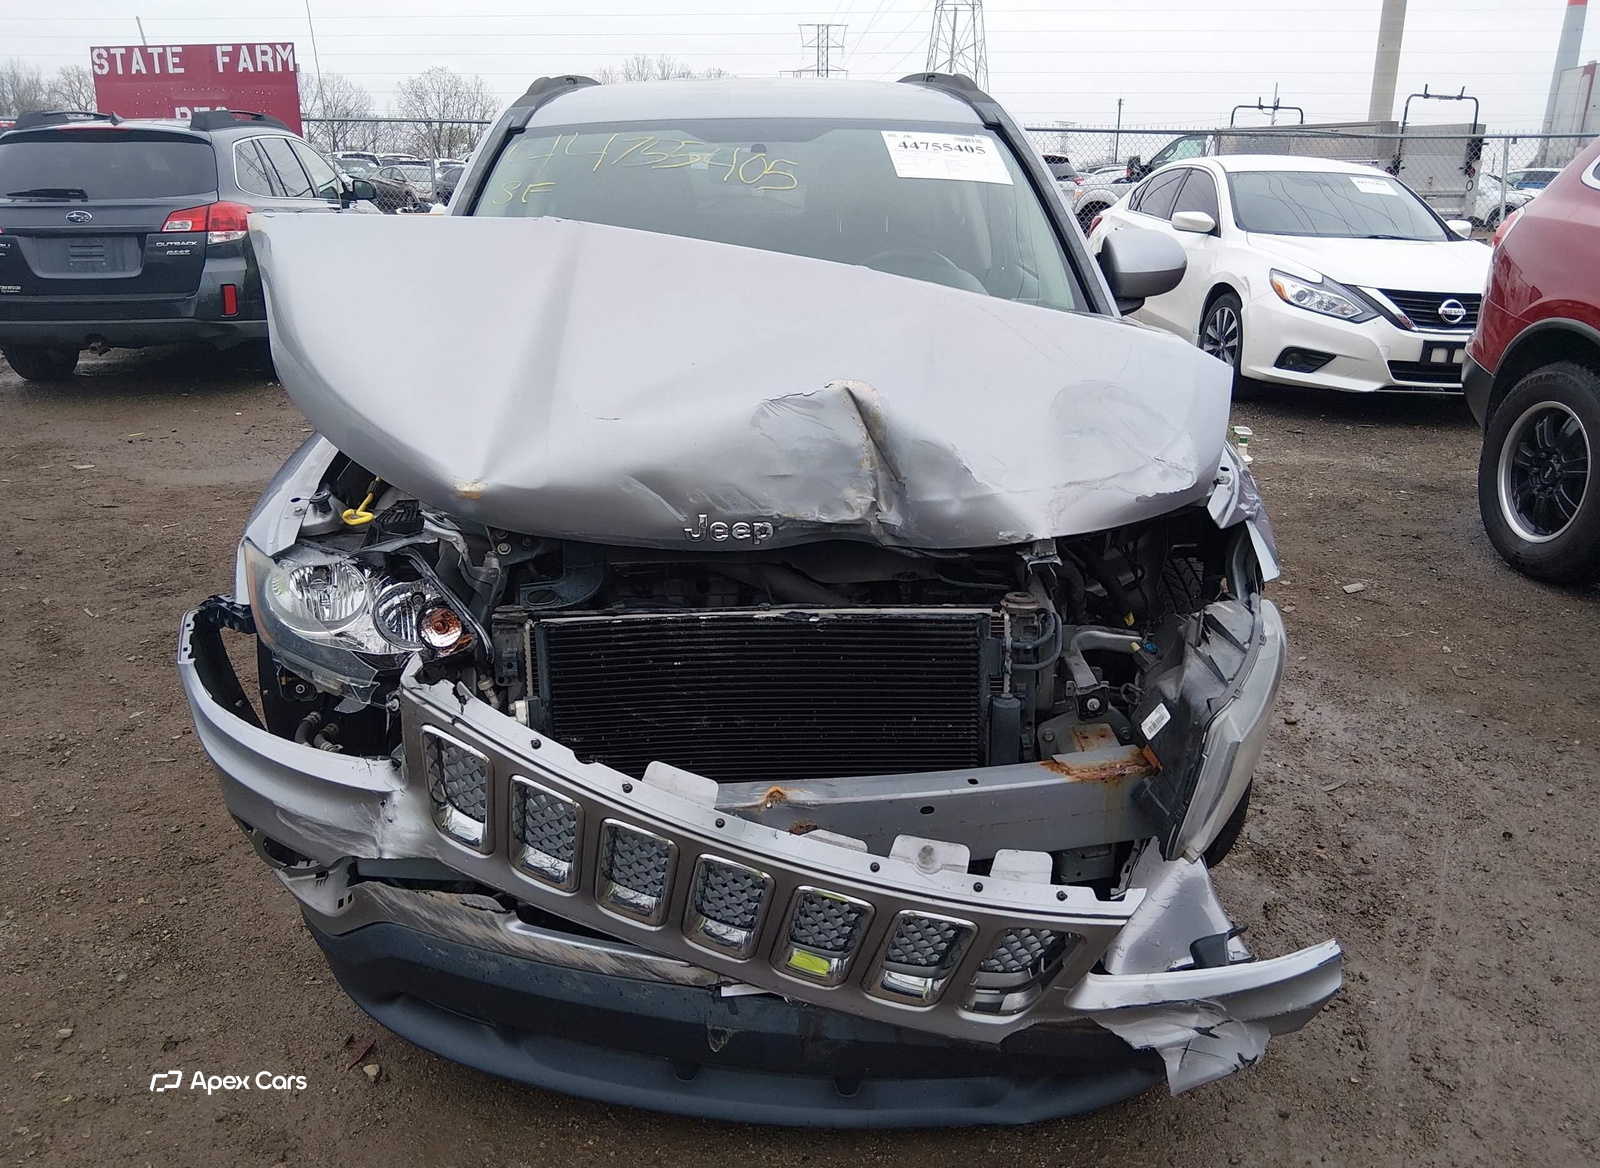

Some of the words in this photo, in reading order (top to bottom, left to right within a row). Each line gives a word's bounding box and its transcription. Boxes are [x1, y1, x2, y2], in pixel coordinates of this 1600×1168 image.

[91, 46, 185, 75] STATE
[215, 44, 295, 73] FARM
[898, 140, 986, 155] 44755405
[683, 513, 775, 546] Jeep
